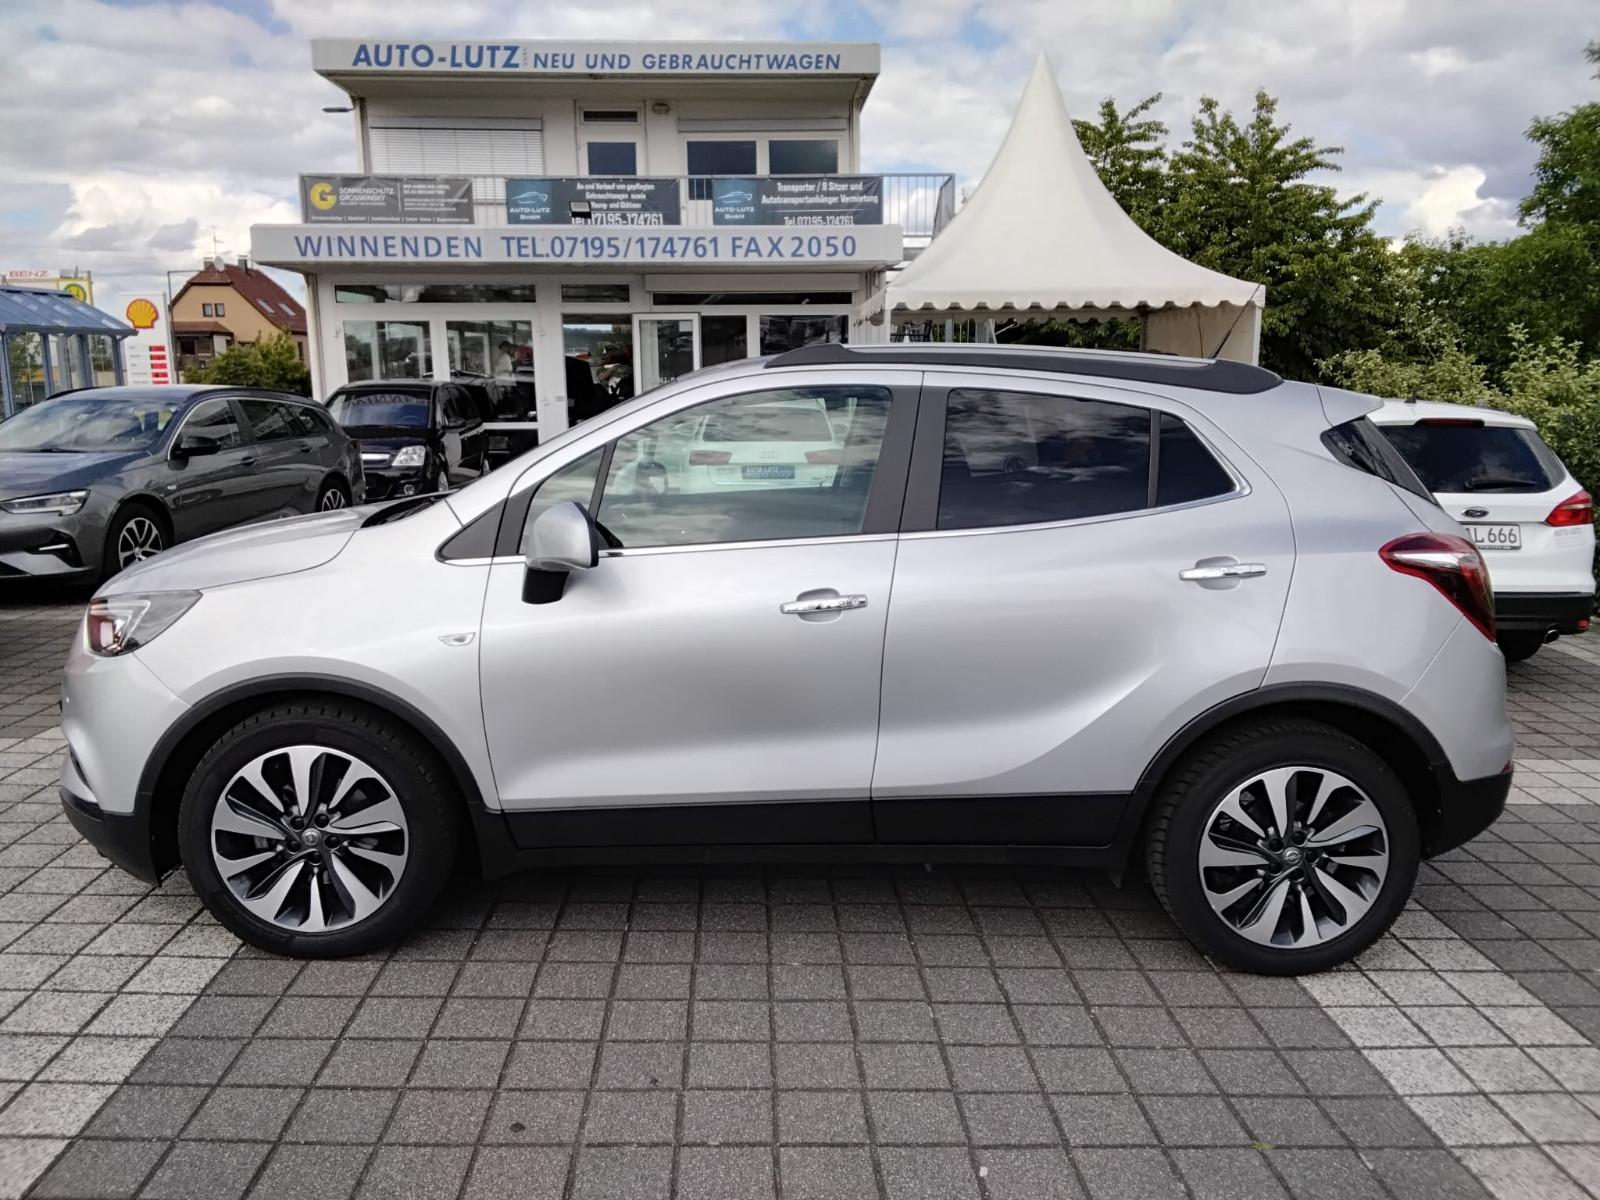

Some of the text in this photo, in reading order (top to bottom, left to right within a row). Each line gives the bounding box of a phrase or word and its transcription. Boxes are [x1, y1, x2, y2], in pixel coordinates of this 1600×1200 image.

[351, 44, 521, 69] AUTO-LUTZ
[533, 52, 575, 69] NEU
[585, 53, 631, 69] UND
[642, 53, 841, 70] GEBRAUCHTWAGEN
[777, 182, 816, 192] Transporter
[828, 182, 849, 191] Sitzer
[850, 181, 863, 191] und
[840, 194, 879, 204] Vermietung
[294, 235, 857, 258] WINNENDEN TEL.07195/174761 FAX 2050
[1487, 527, 1517, 543] 666
